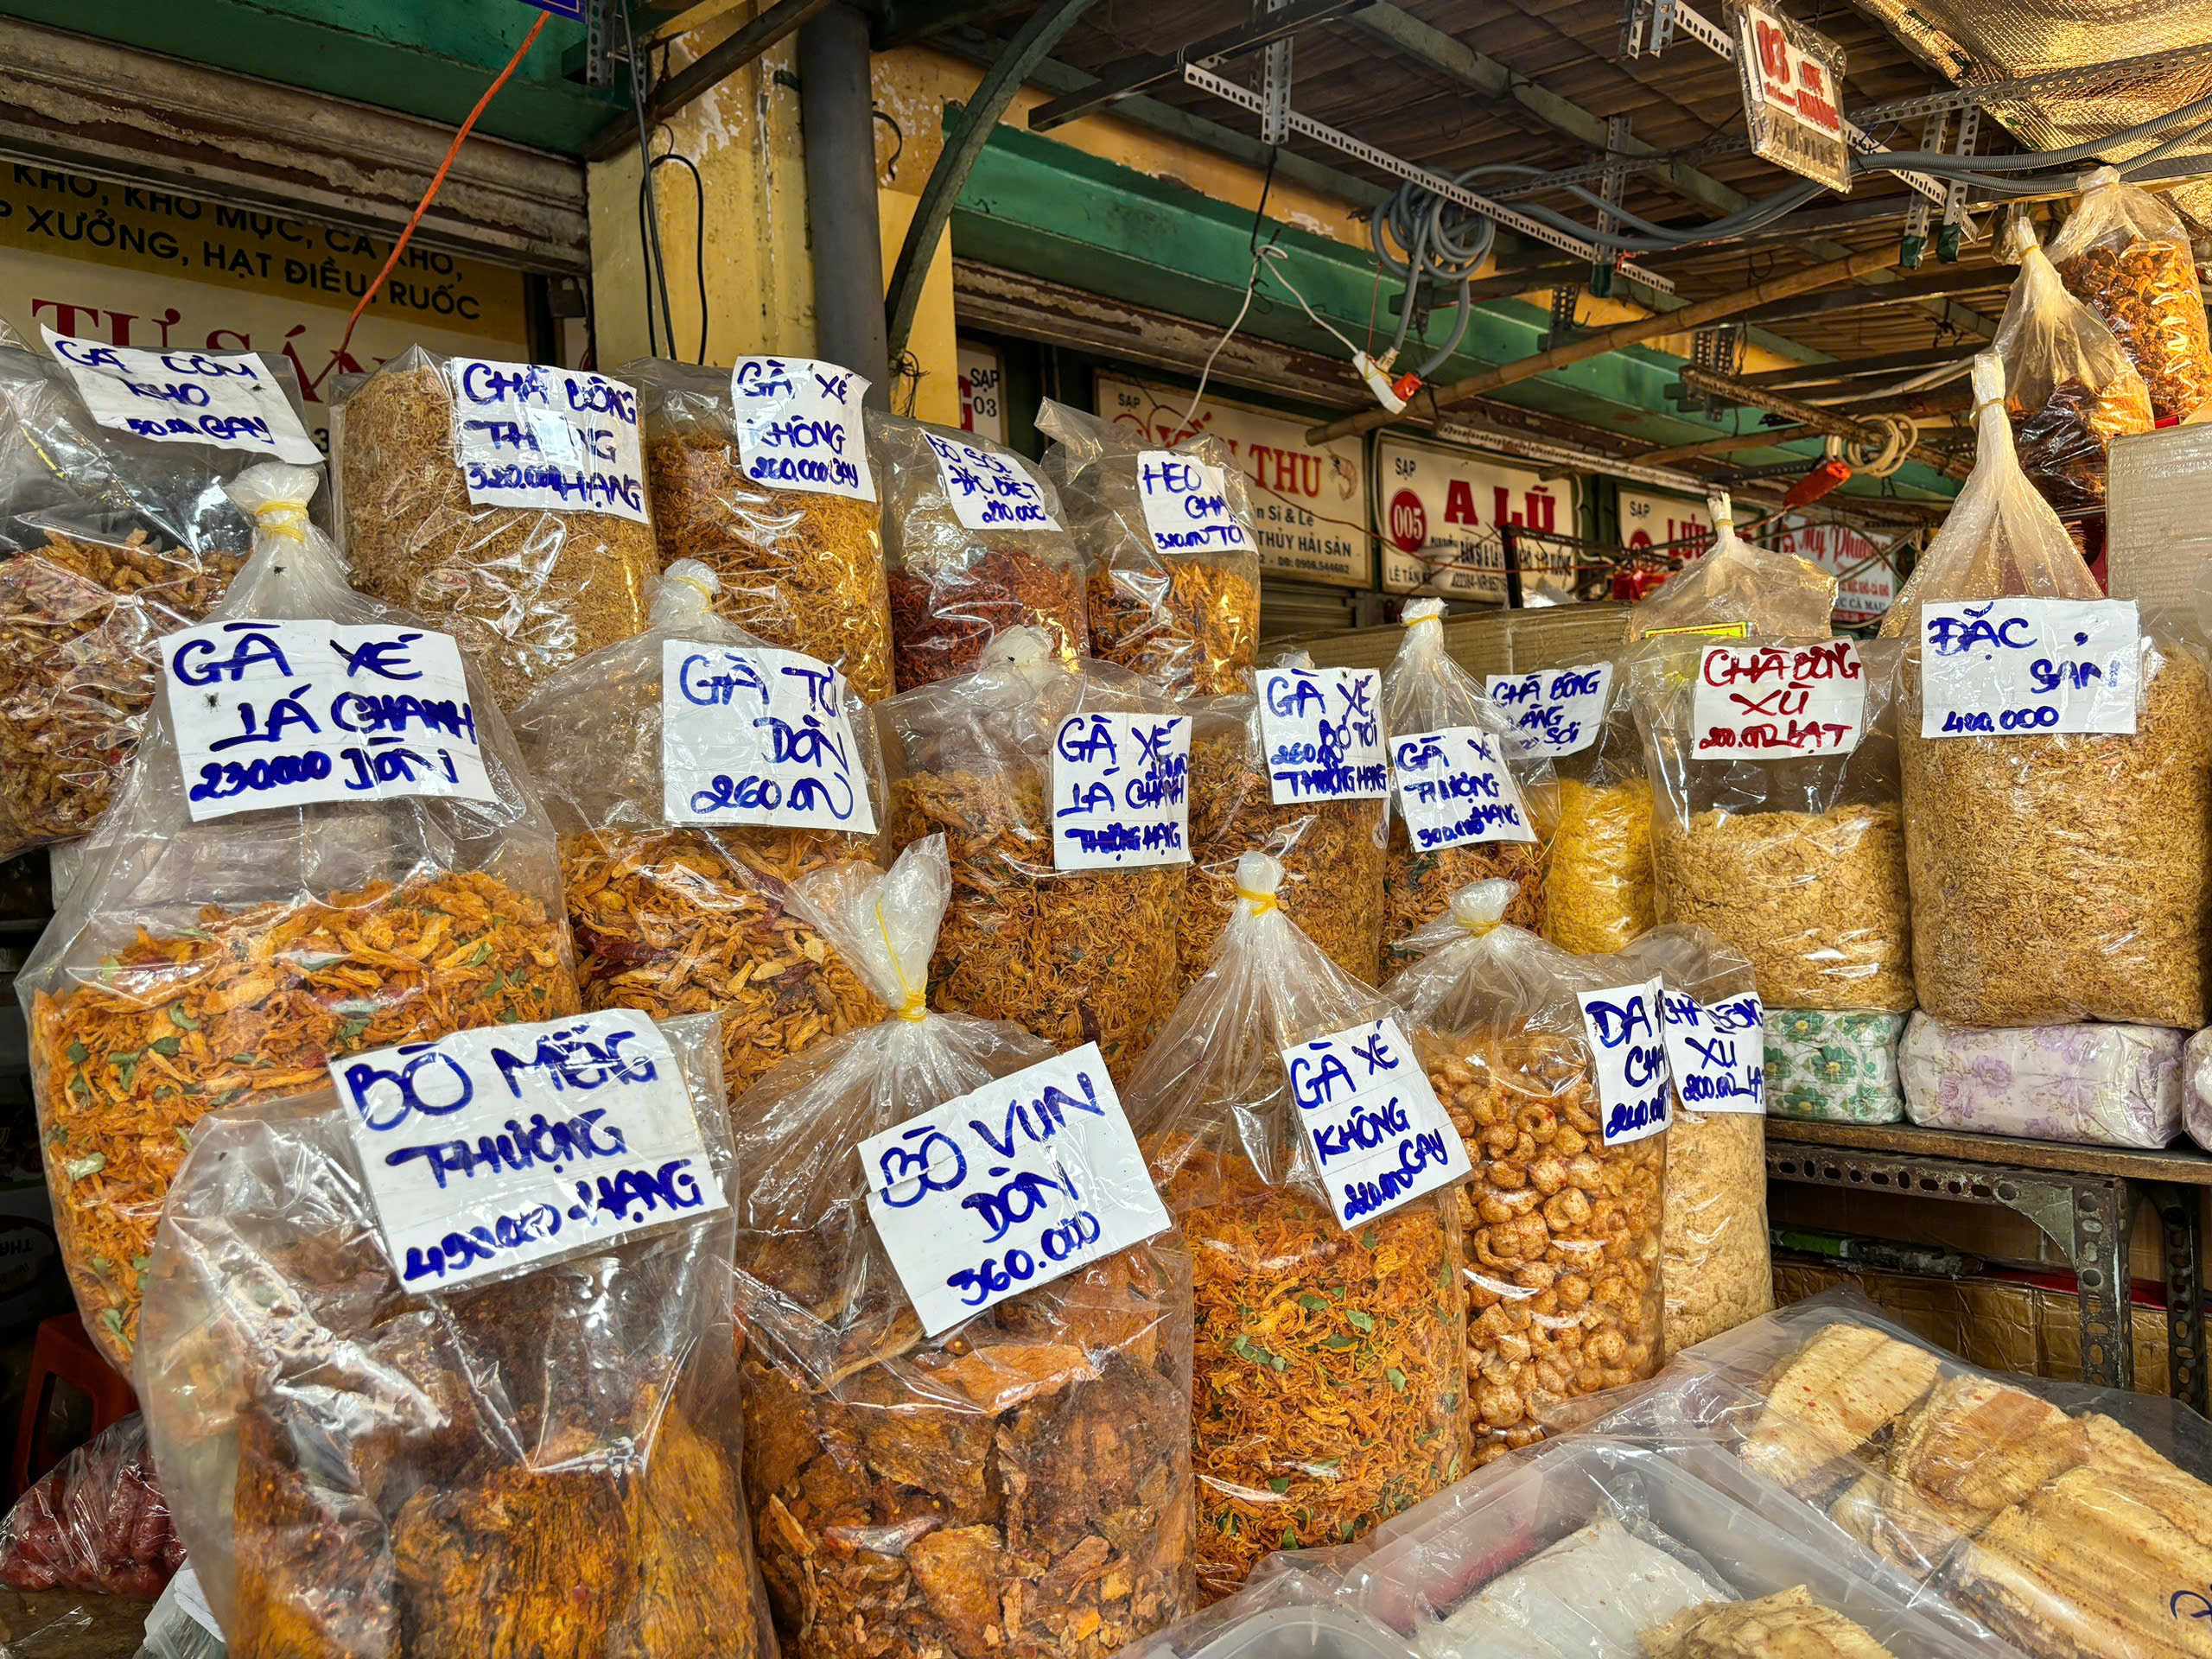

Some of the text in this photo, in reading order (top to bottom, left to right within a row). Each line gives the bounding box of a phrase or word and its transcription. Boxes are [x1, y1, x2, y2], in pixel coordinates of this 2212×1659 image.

[27, 208, 188, 266] XƯỞNG,
[203, 240, 272, 279] HẠT
[390, 280, 480, 320] RUỐC
[737, 359, 796, 400] GÀ
[973, 396, 997, 418] 03
[1142, 461, 1203, 495] HEO
[1249, 443, 1323, 498] THU
[1285, 508, 1295, 524] &
[1394, 504, 1424, 540] 005
[1444, 479, 1479, 526] A
[1257, 528, 1352, 557] THỦY HẢI SẢN
[172, 622, 423, 687] GÀ XÉ
[1928, 601, 2037, 660] ĐẶC
[679, 652, 771, 707] GÀ
[1493, 670, 1602, 708] CHÀ BÔNG
[1704, 643, 1862, 688] CHÀ BÔNG
[209, 683, 478, 753] LÁ CHANH
[1267, 668, 1374, 719] GÀ XÉ
[1729, 681, 1815, 716] XÙ
[753, 715, 851, 777] DÒN
[1058, 714, 1183, 766] GÀ XÉ
[1396, 735, 1450, 772] GÀ
[1057, 766, 1121, 817] LÁ
[345, 1043, 474, 1131] BÒ
[1290, 1020, 1400, 1110] GÀ XÉ
[1313, 1096, 1411, 1166] KHÔNG
[880, 1125, 968, 1208] BÒ
